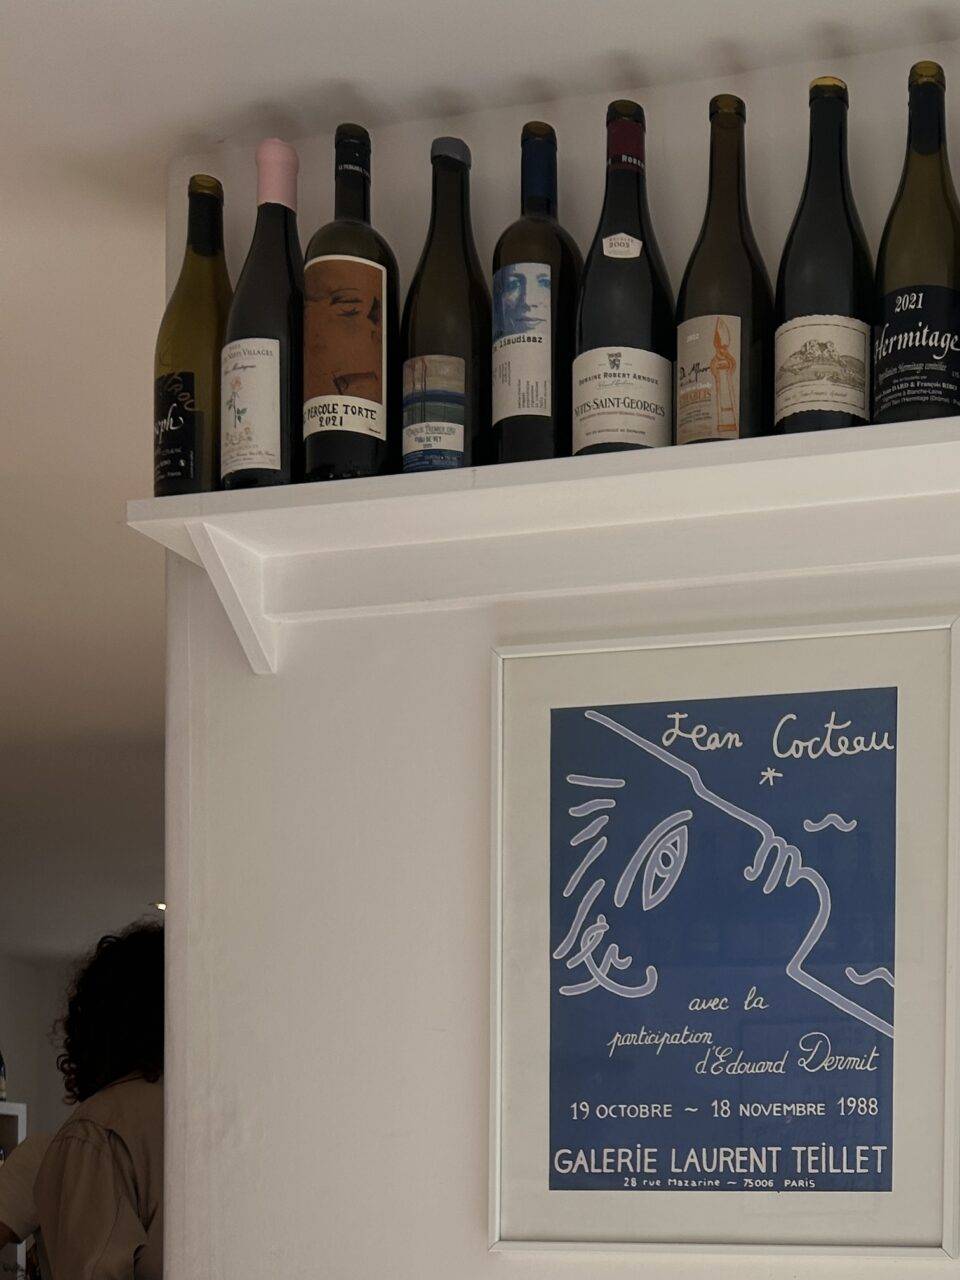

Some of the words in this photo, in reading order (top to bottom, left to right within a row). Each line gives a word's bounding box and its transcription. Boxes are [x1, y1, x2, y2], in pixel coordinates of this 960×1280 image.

[894, 292, 924, 313] 2021
[603, 372, 630, 380] ROBERT
[319, 415, 344, 428] 2021
[342, 404, 377, 420] TORTE
[661, 712, 743, 751] Jean
[772, 711, 895, 759] Cocteau
[688, 996, 730, 1011] avec
[744, 986, 769, 1011] la
[607, 1025, 714, 1058] participation
[797, 1031, 880, 1073] Dermit
[570, 1101, 590, 1120] 19
[596, 1104, 673, 1119] OCTOBRE
[711, 1099, 731, 1118] 18
[739, 1103, 826, 1117] NOVEMBRE
[837, 1096, 879, 1116] 1988
[670, 1146, 782, 1174] LAURENT
[623, 1177, 637, 1188] 28
[643, 1179, 662, 1187] rue
[667, 1177, 721, 1188] Mazarine
[743, 1178, 774, 1188] 75006
